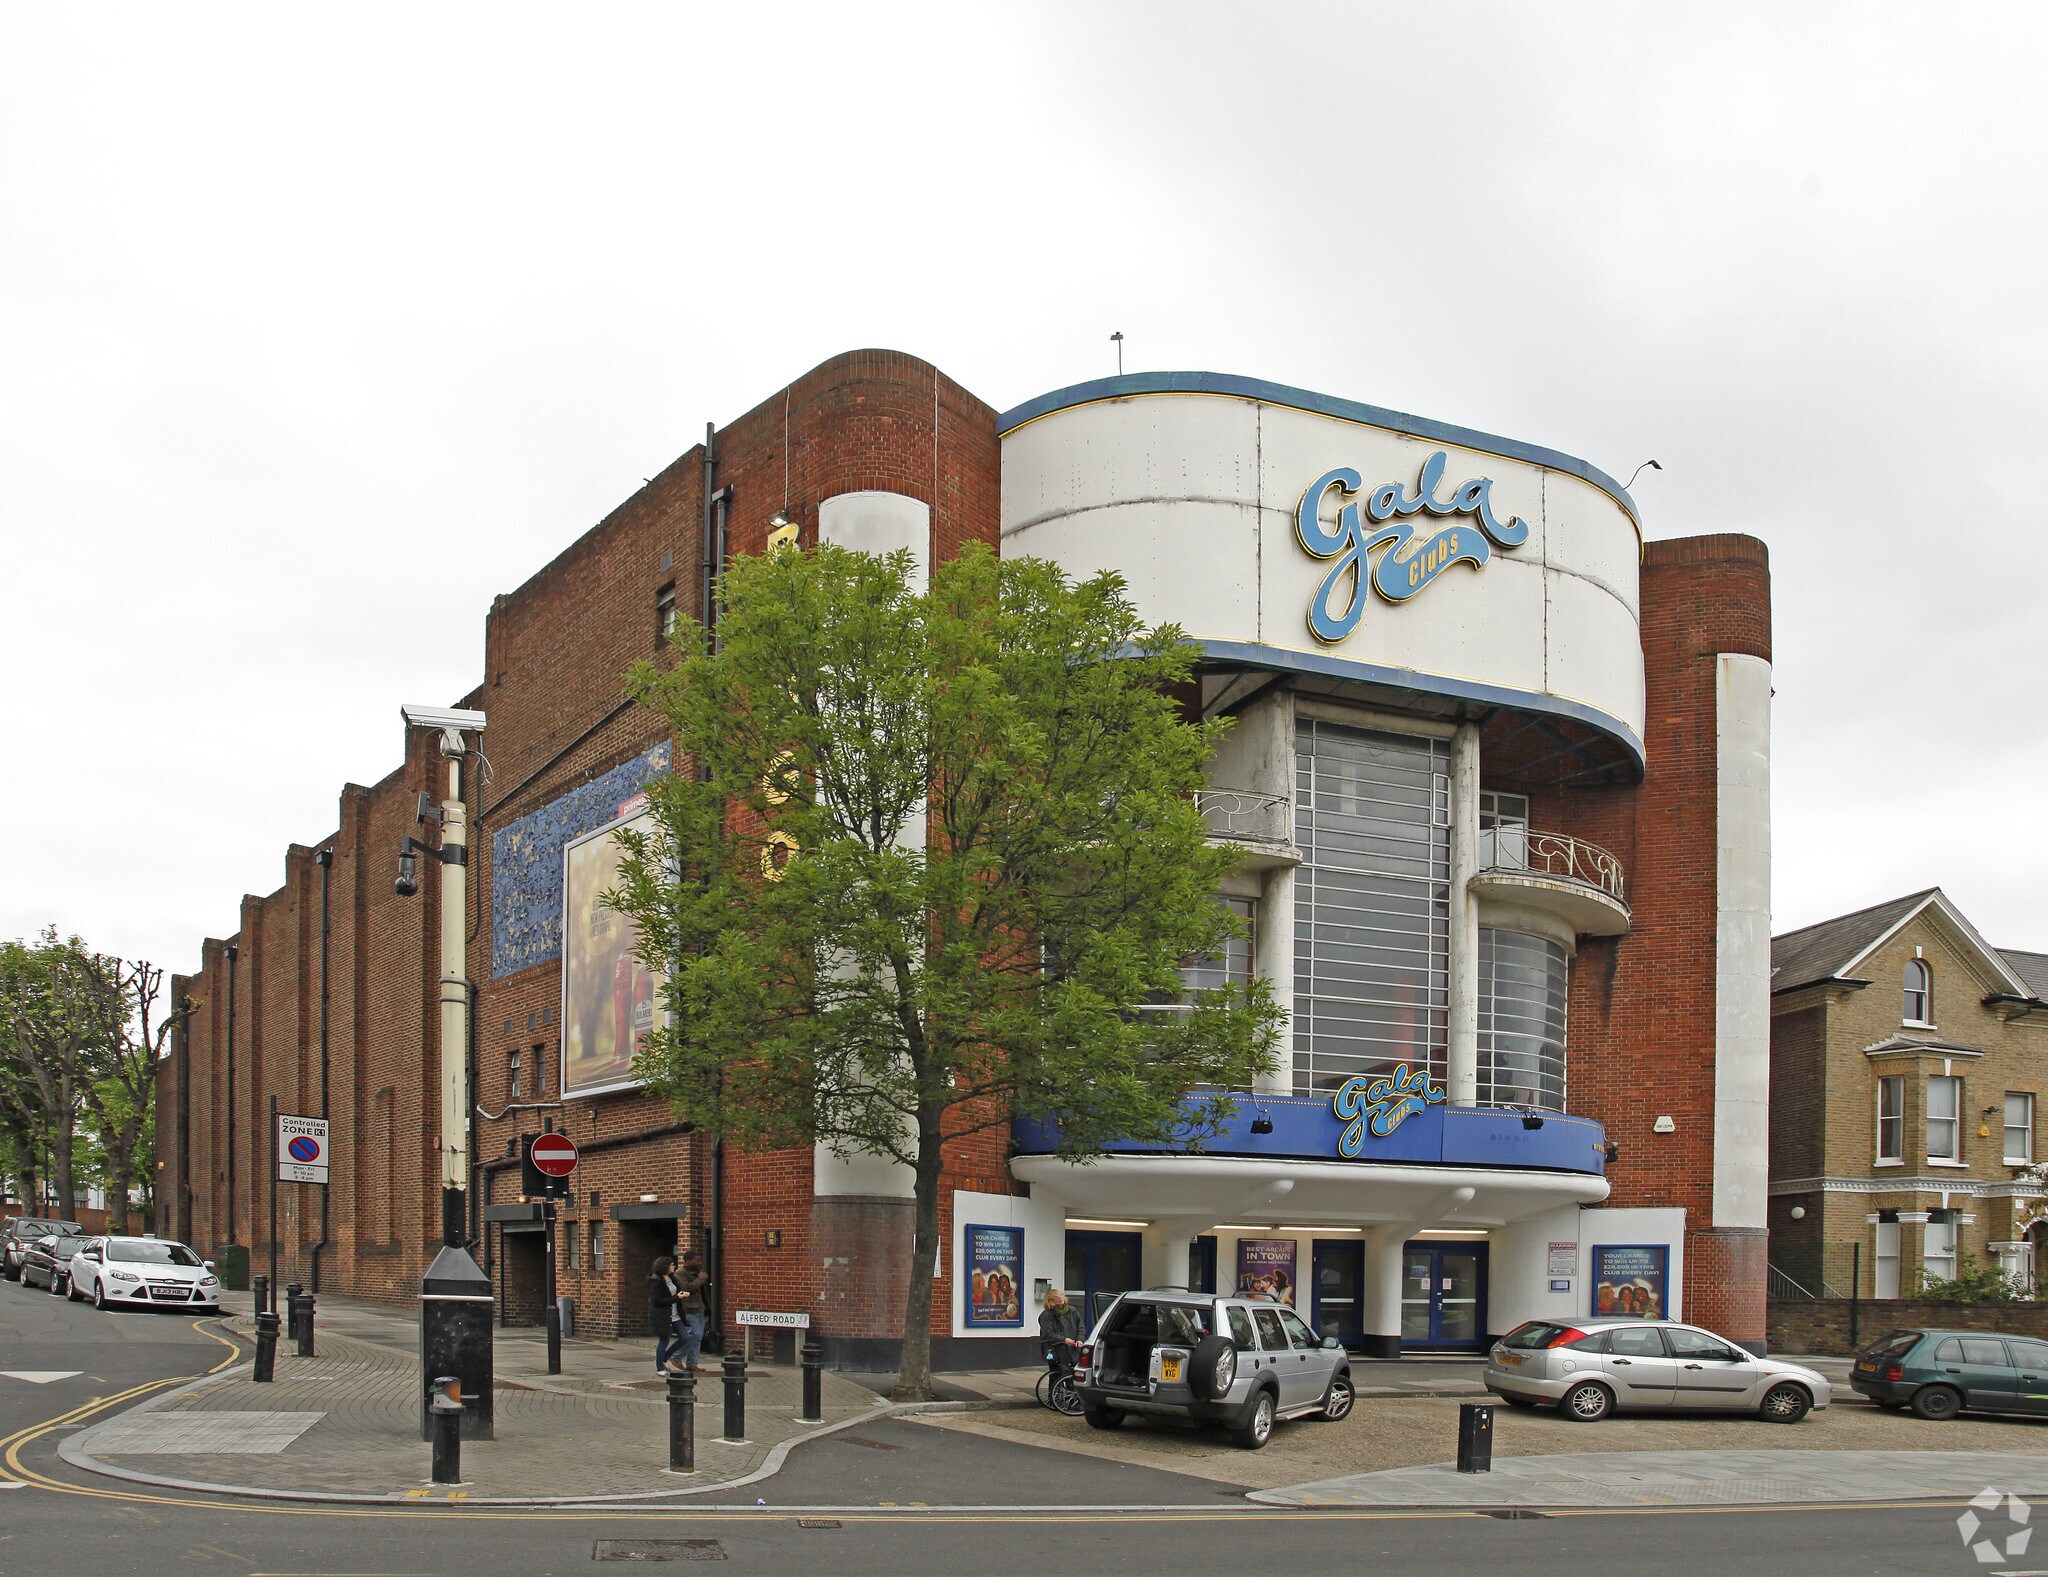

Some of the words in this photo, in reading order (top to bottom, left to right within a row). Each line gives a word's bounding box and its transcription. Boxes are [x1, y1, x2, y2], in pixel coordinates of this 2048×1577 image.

[282, 1117, 326, 1128] Controlled
[282, 1125, 313, 1136] ZONE
[1246, 1252, 1258, 1260] IN
[1260, 1252, 1291, 1260] TOWN
[740, 1314, 770, 1323] ALFRED
[773, 1315, 796, 1324] ROAD
